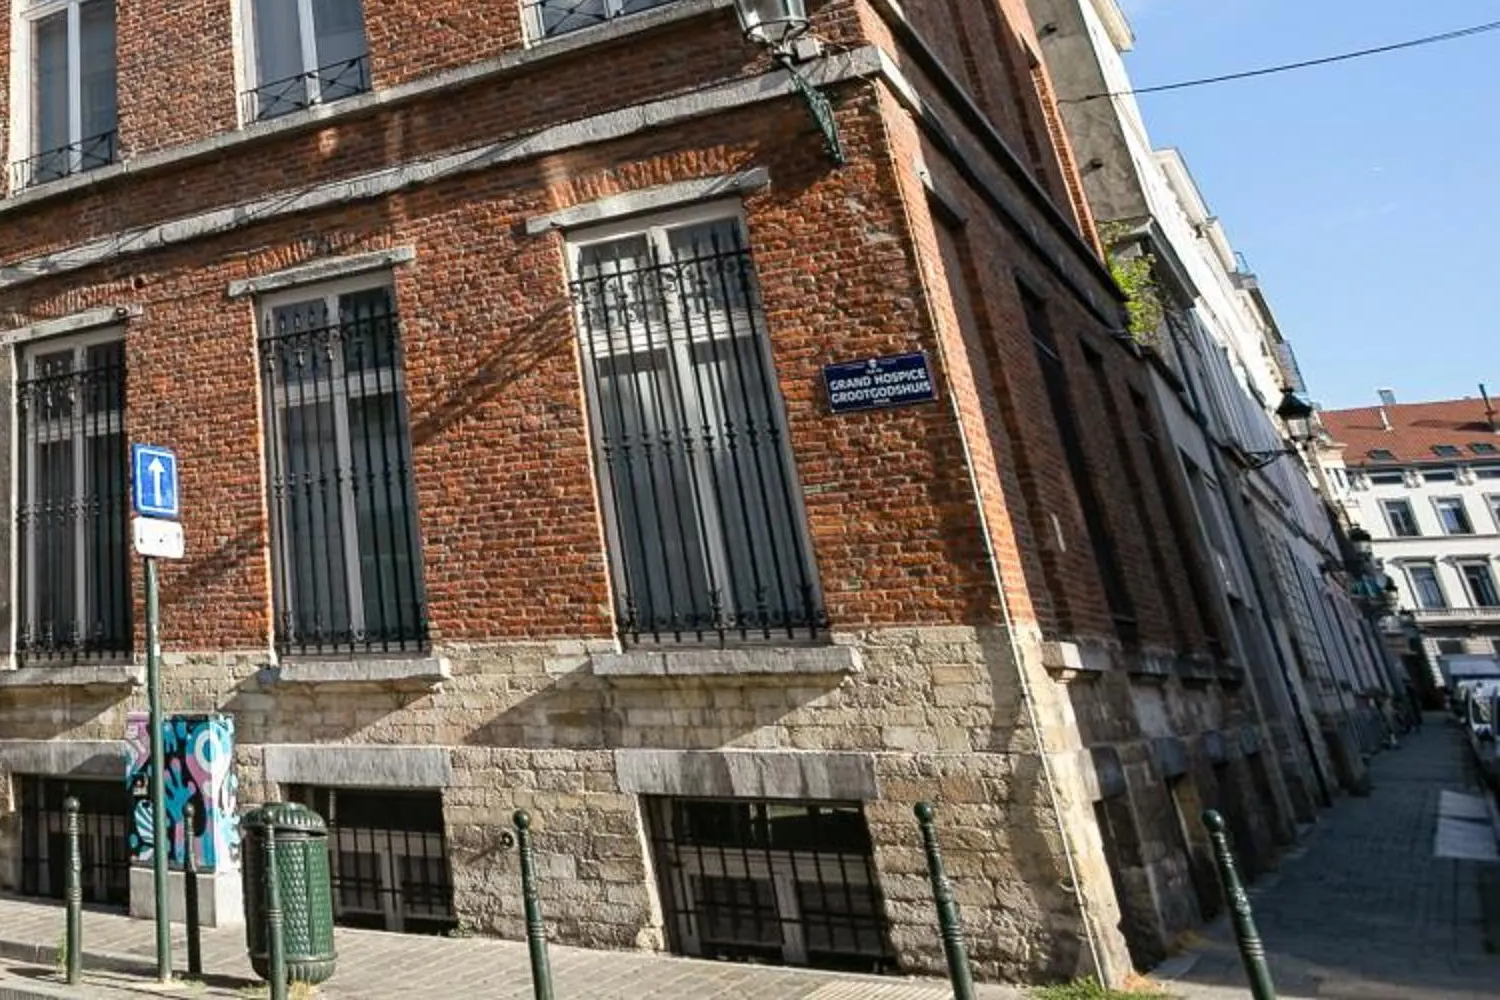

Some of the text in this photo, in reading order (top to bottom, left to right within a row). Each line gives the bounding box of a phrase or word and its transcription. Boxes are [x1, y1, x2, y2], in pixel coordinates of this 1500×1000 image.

[830, 375, 871, 391] GRAND
[874, 367, 927, 385] HOSPICE
[831, 381, 932, 403] GROOTGODSHUIS
